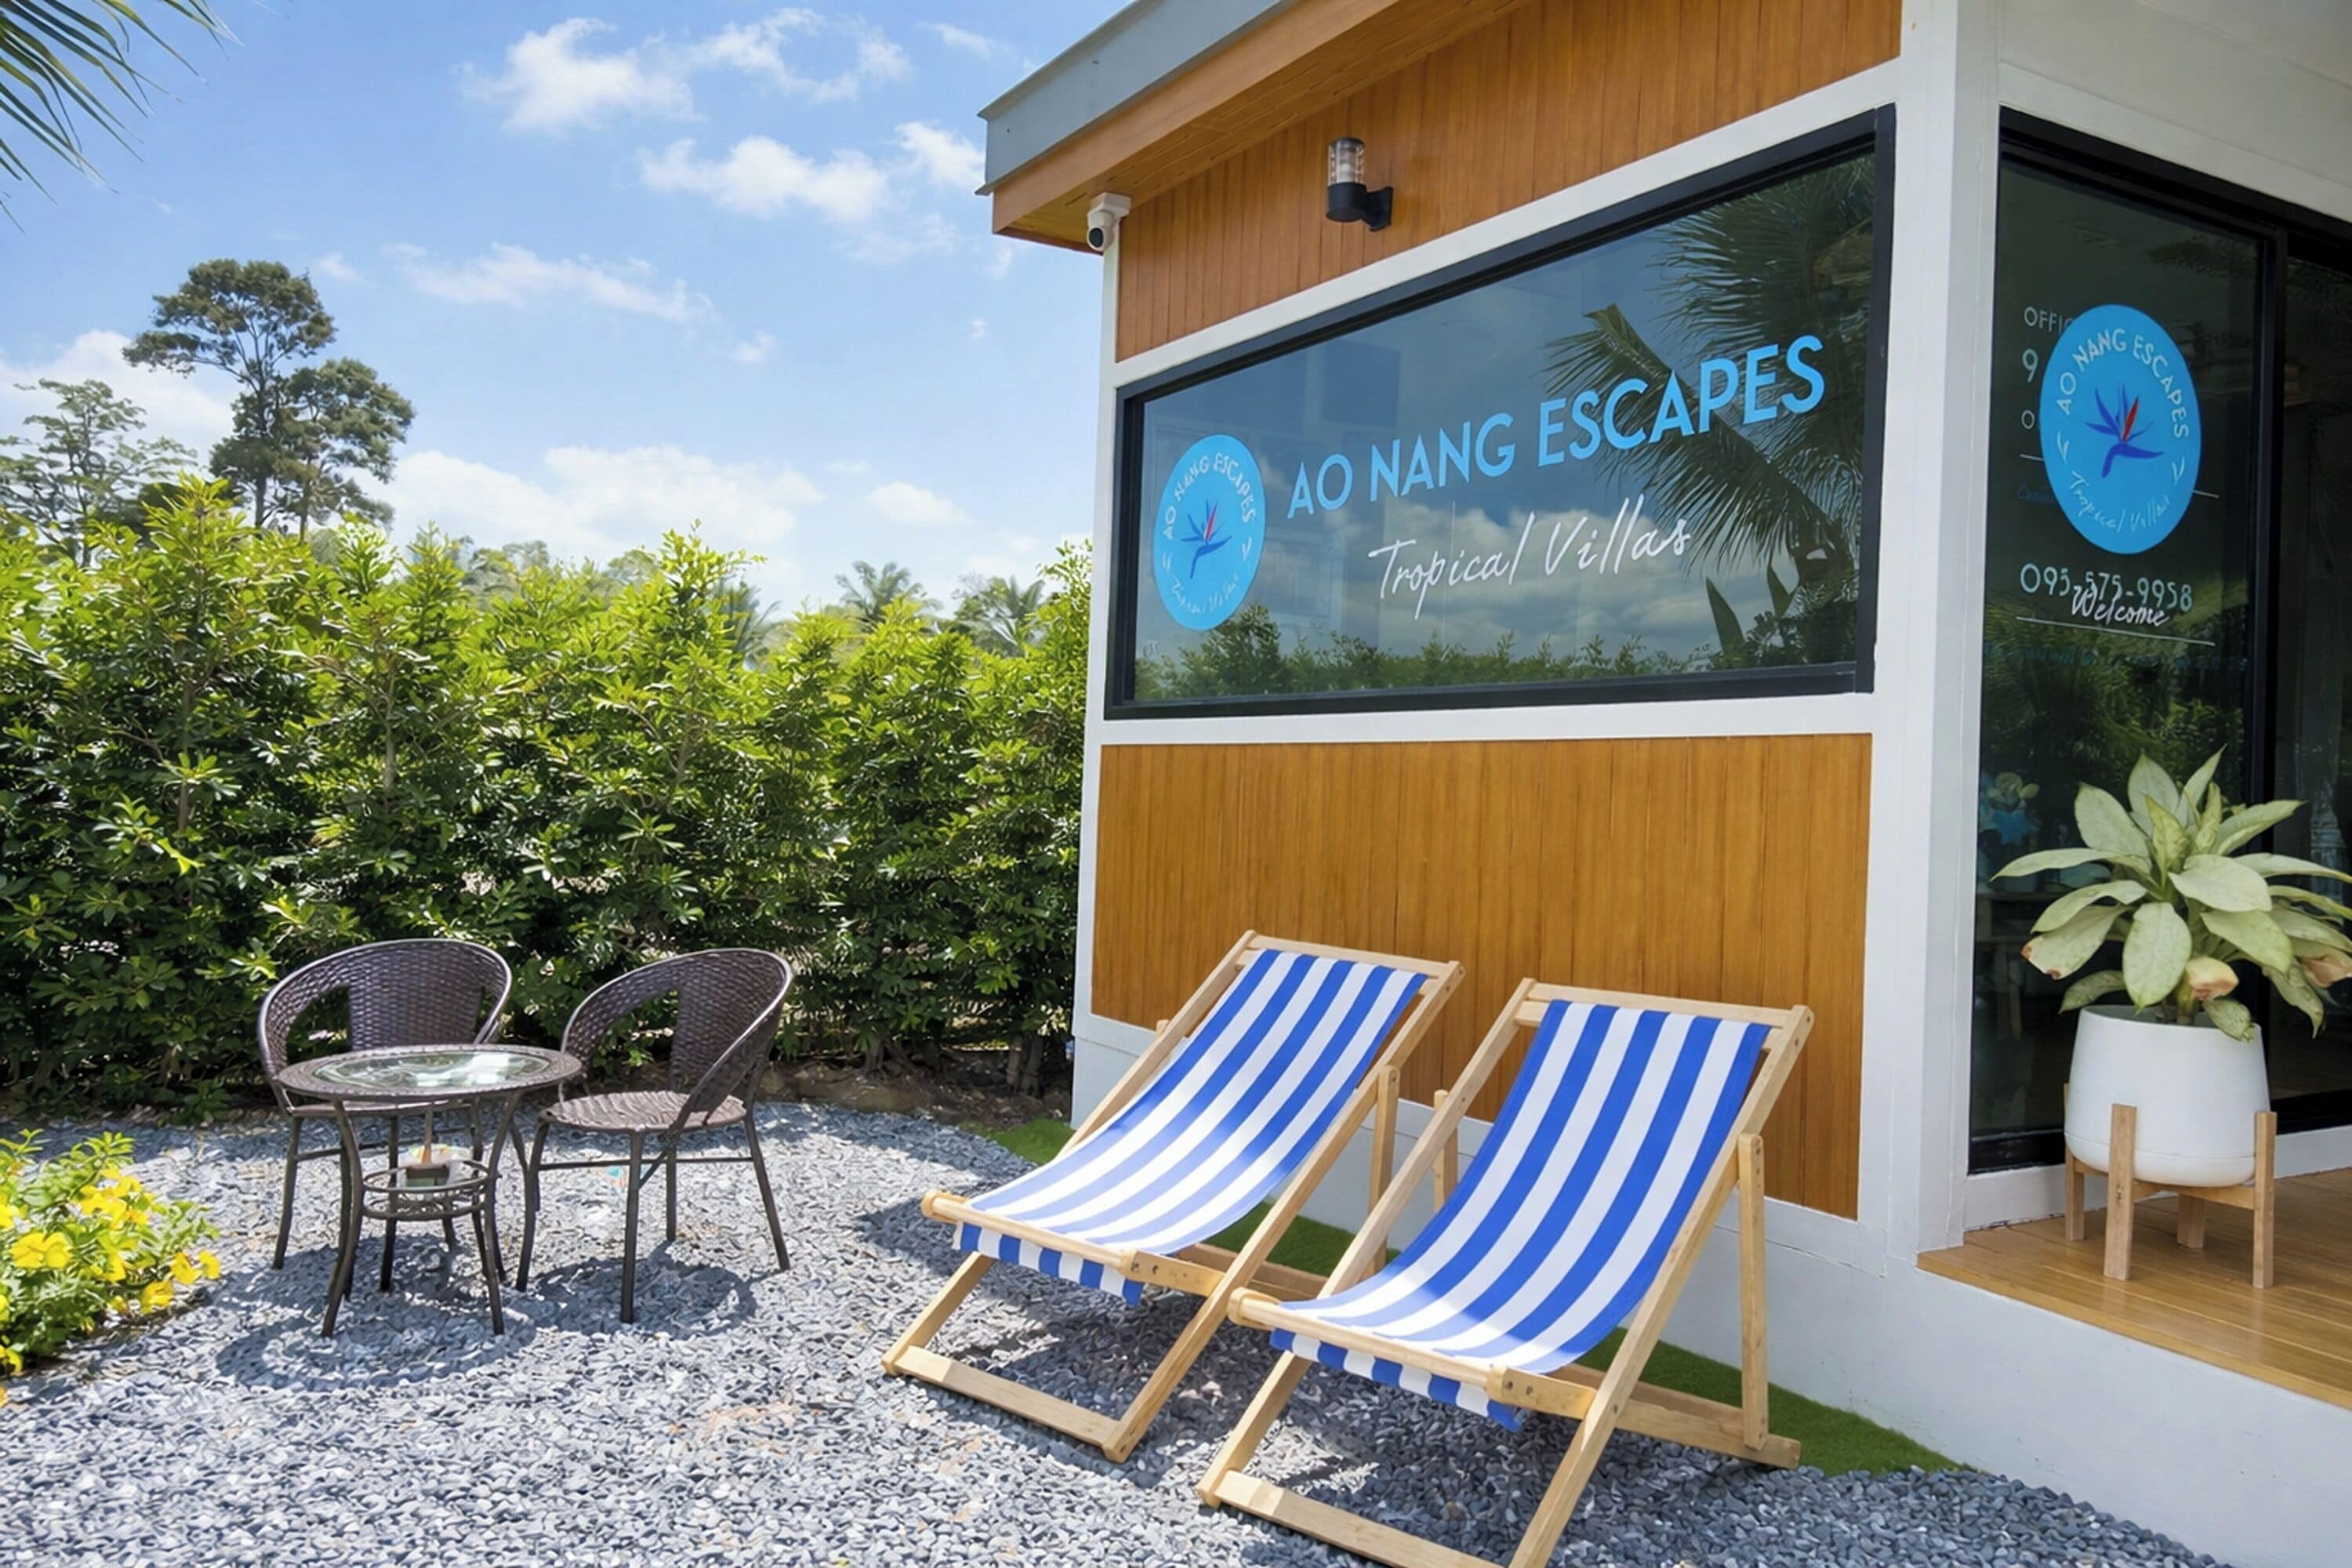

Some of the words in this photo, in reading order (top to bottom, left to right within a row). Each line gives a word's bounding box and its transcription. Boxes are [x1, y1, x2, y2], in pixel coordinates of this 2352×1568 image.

[2023, 307, 2072, 333] OFFI
[1287, 454, 1353, 519] AO
[1369, 413, 1515, 503] NANG
[1537, 335, 1826, 468] ESCAPES
[2056, 372, 2076, 415] AO
[2072, 328, 2127, 371] NANG
[2133, 335, 2189, 438] ESCAPES
[1163, 506, 1176, 539] AO
[1214, 452, 1256, 522] ESCAPES
[1368, 511, 1537, 620] Tropical
[1544, 494, 1692, 576] Villas
[2071, 584, 2170, 626] Welcome
